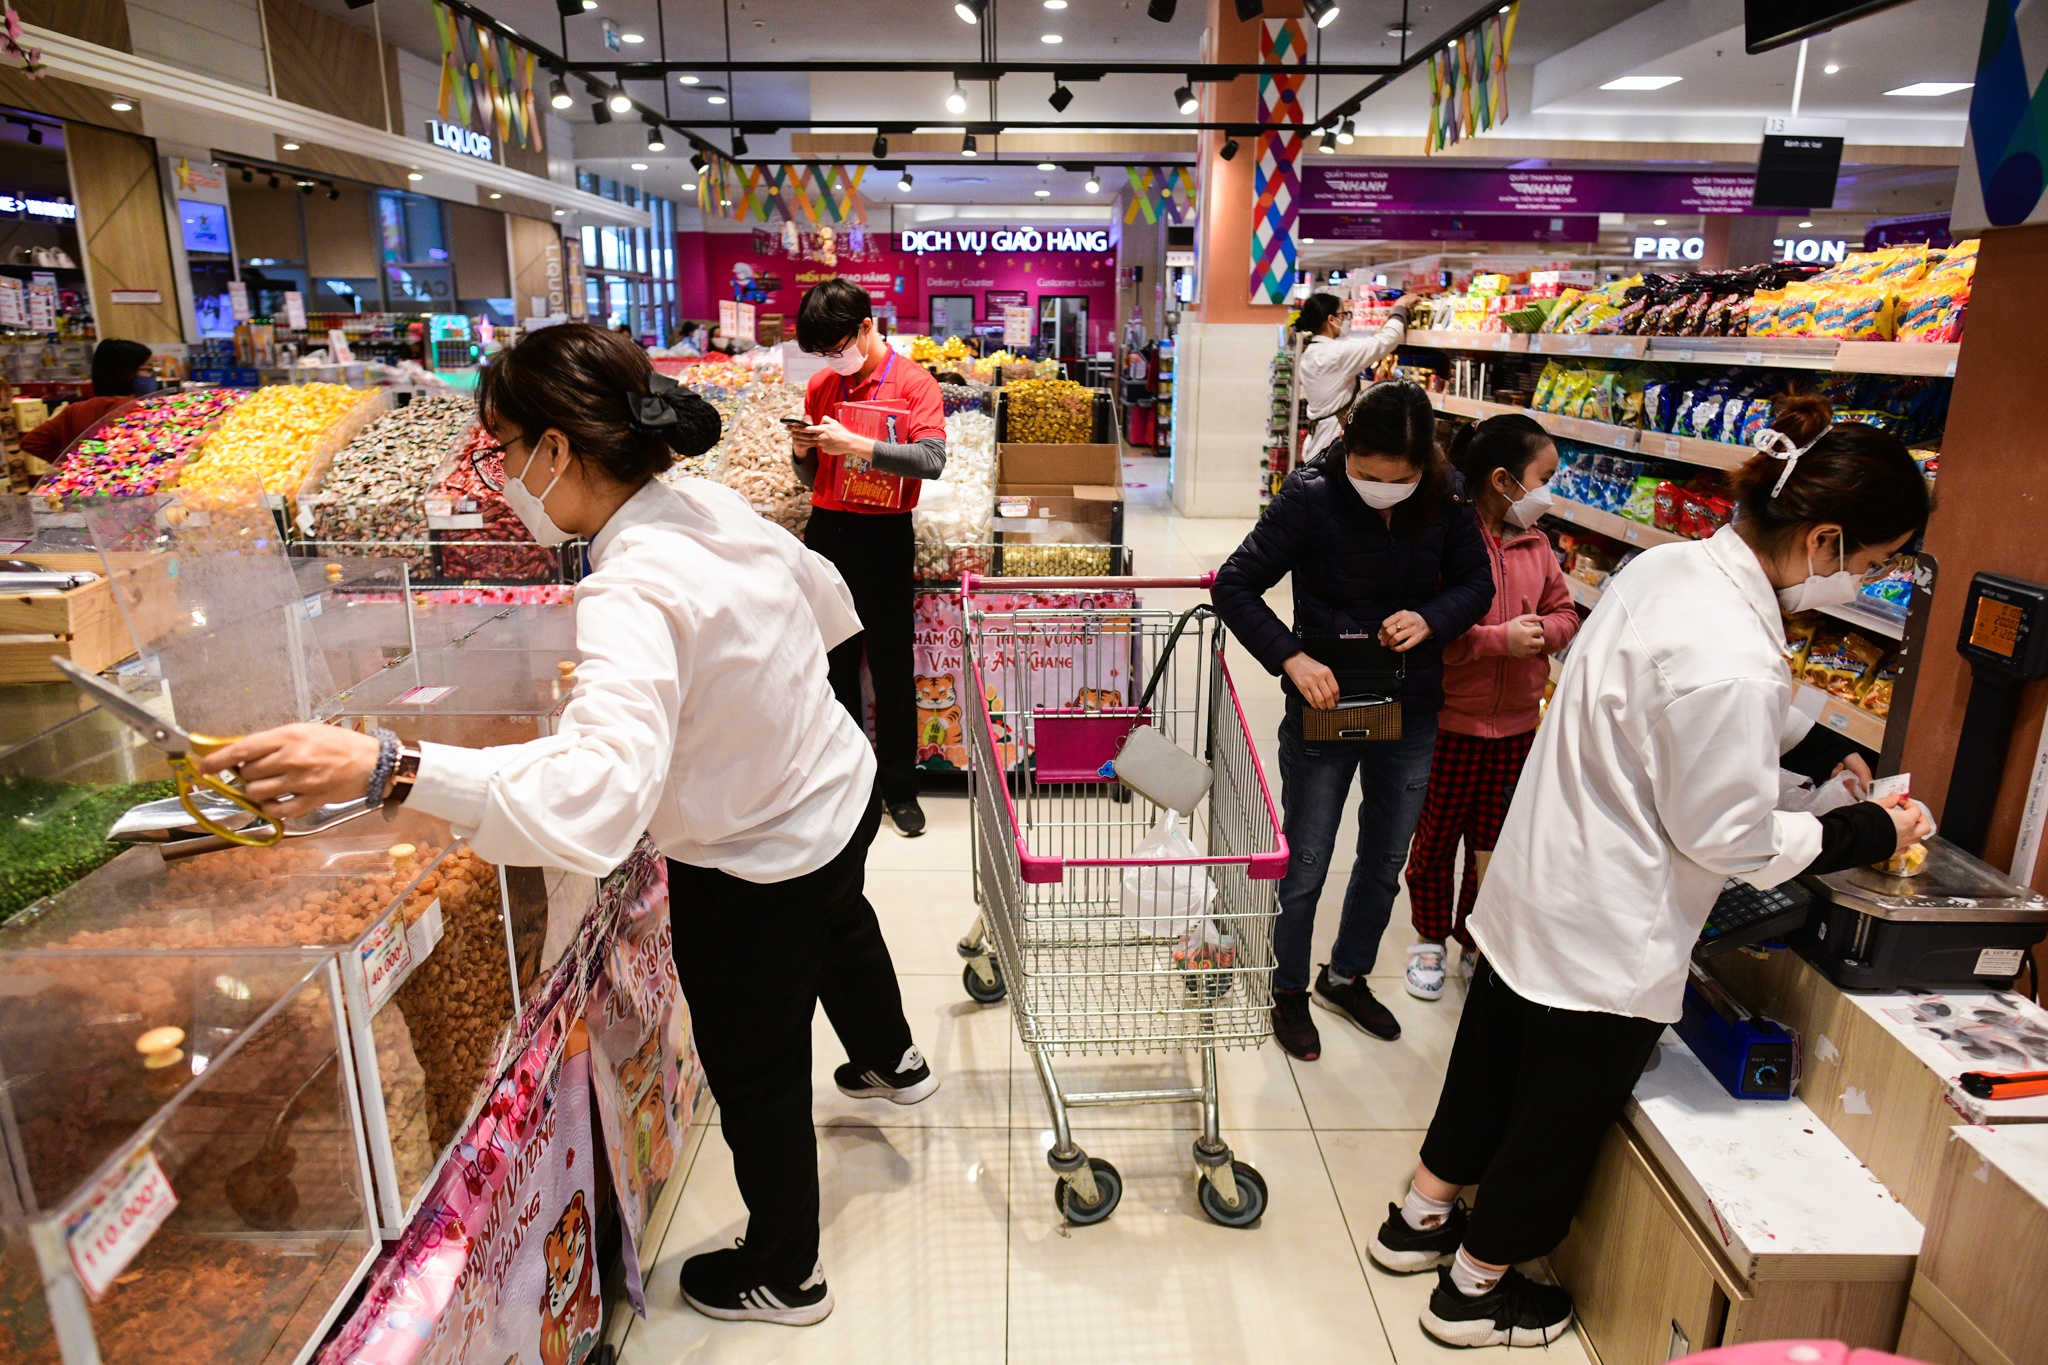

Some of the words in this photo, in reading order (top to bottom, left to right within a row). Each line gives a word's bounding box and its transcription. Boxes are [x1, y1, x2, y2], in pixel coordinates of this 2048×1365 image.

[1770, 119, 1785, 132] 13
[431, 119, 493, 161] LIQUOR
[1338, 180, 1388, 192] NHANH
[1524, 183, 1572, 195] NHANH
[901, 230, 951, 256] DỊCH
[956, 231, 987, 256] VỤ
[1046, 228, 1109, 252] HÀNG
[927, 278, 960, 288] Delivery
[962, 278, 995, 287] Counter
[1037, 278, 1076, 287] Customer
[1078, 278, 1106, 287] Locker
[913, 630, 944, 645] HÂM
[926, 650, 961, 672] VẠN
